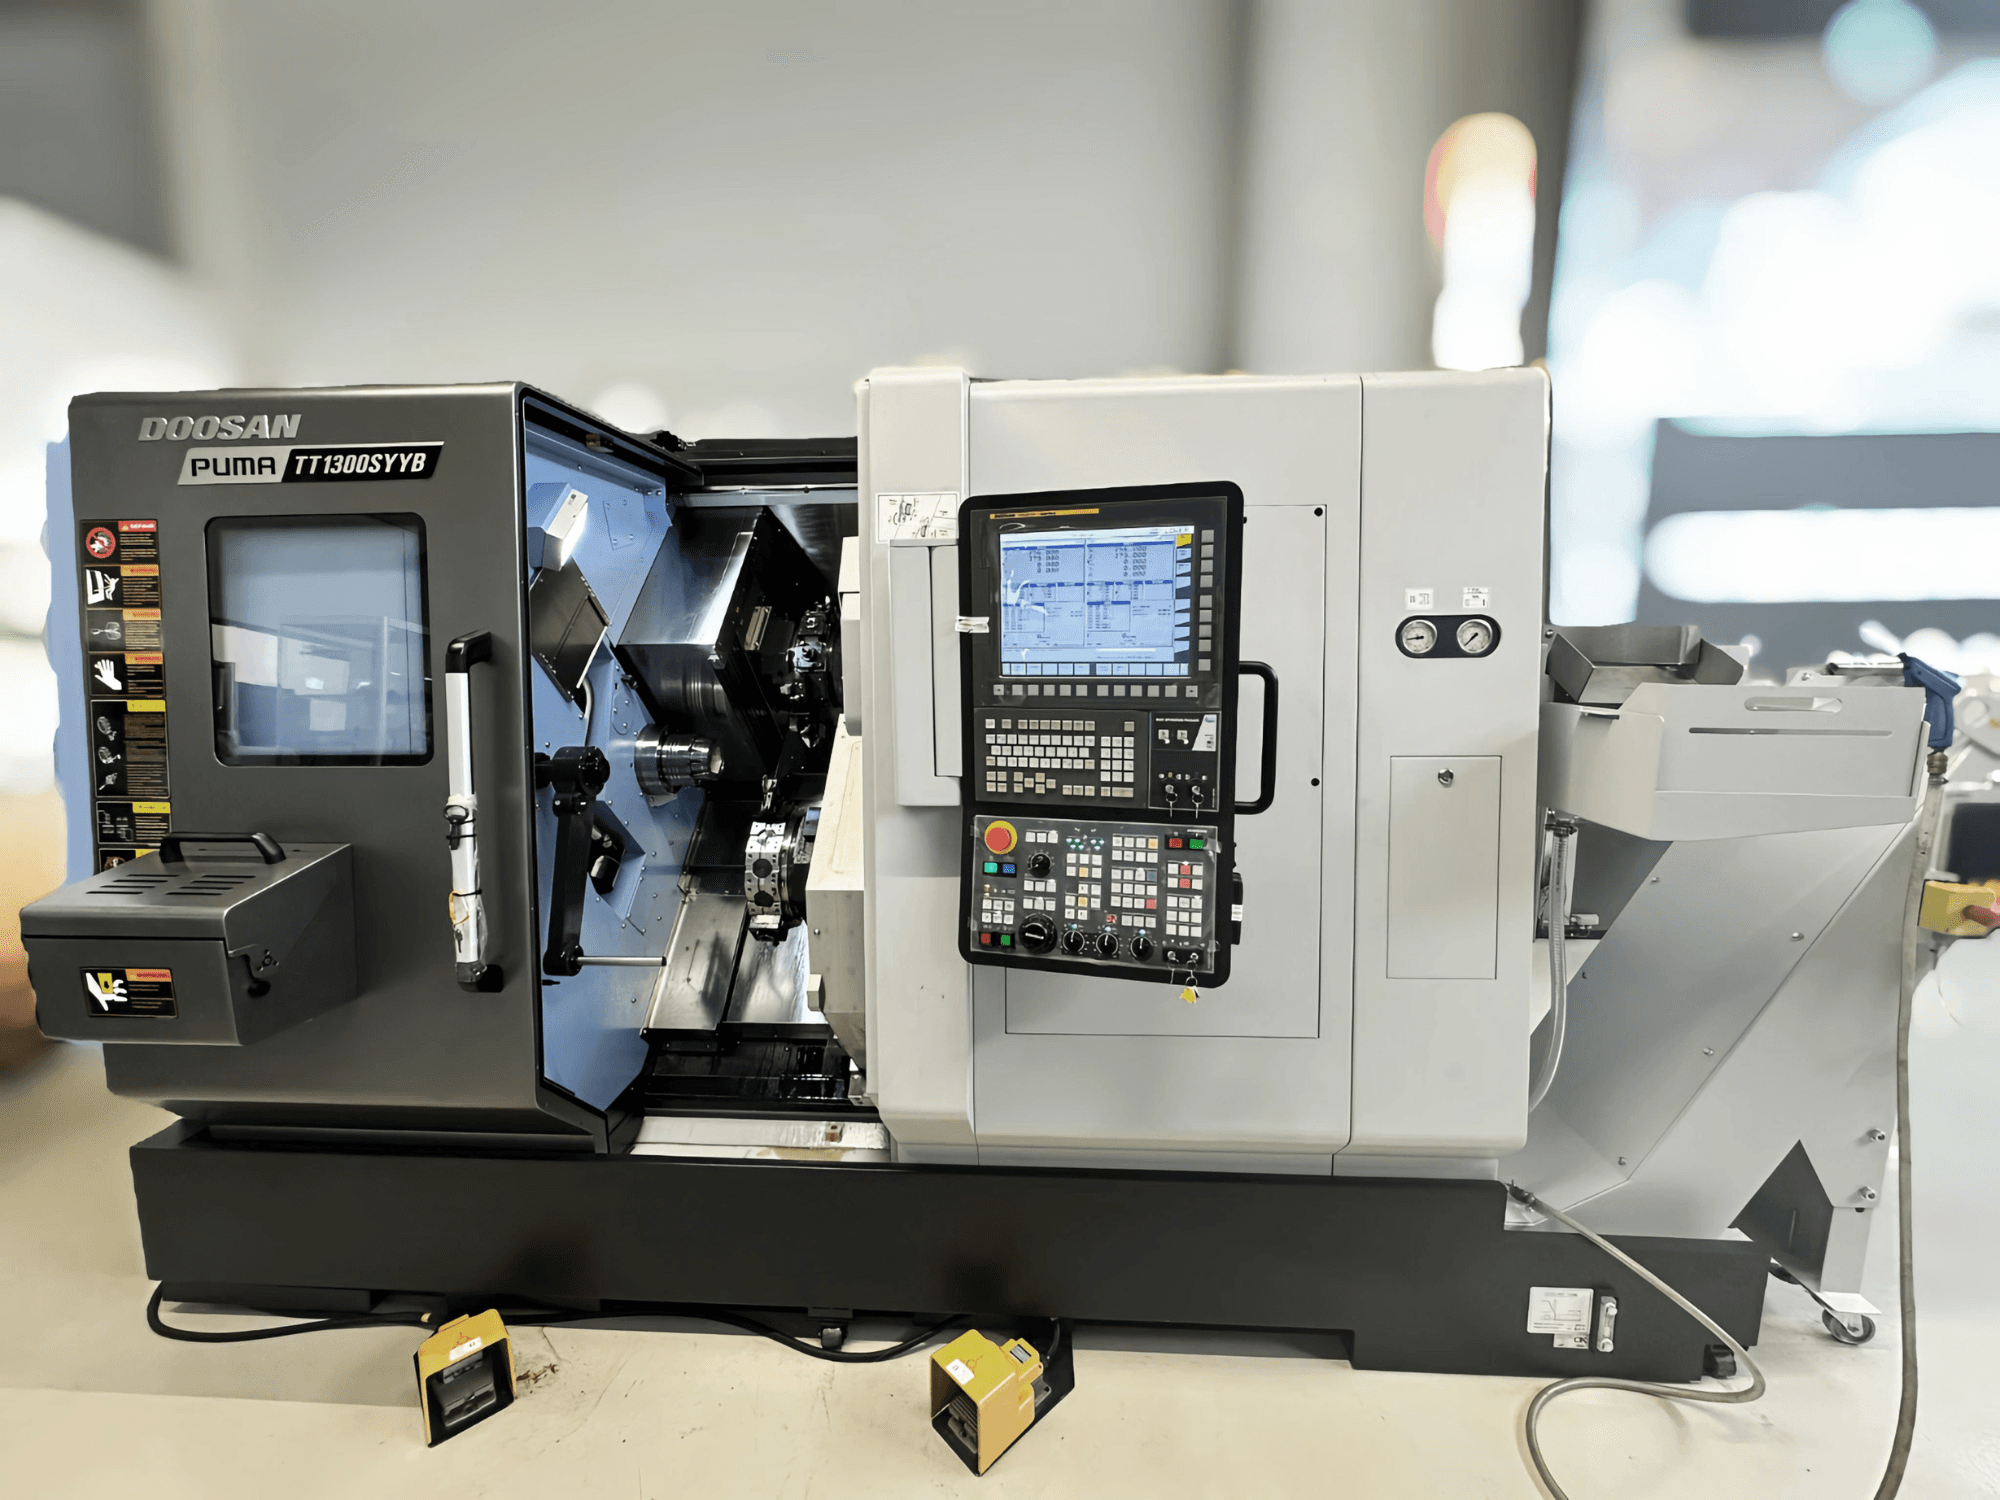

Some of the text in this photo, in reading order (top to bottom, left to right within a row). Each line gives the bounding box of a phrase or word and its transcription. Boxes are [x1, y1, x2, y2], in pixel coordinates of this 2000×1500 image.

[138, 414, 302, 441] DOOSAN
[191, 453, 427, 477] PUMA TT1300SYYB
